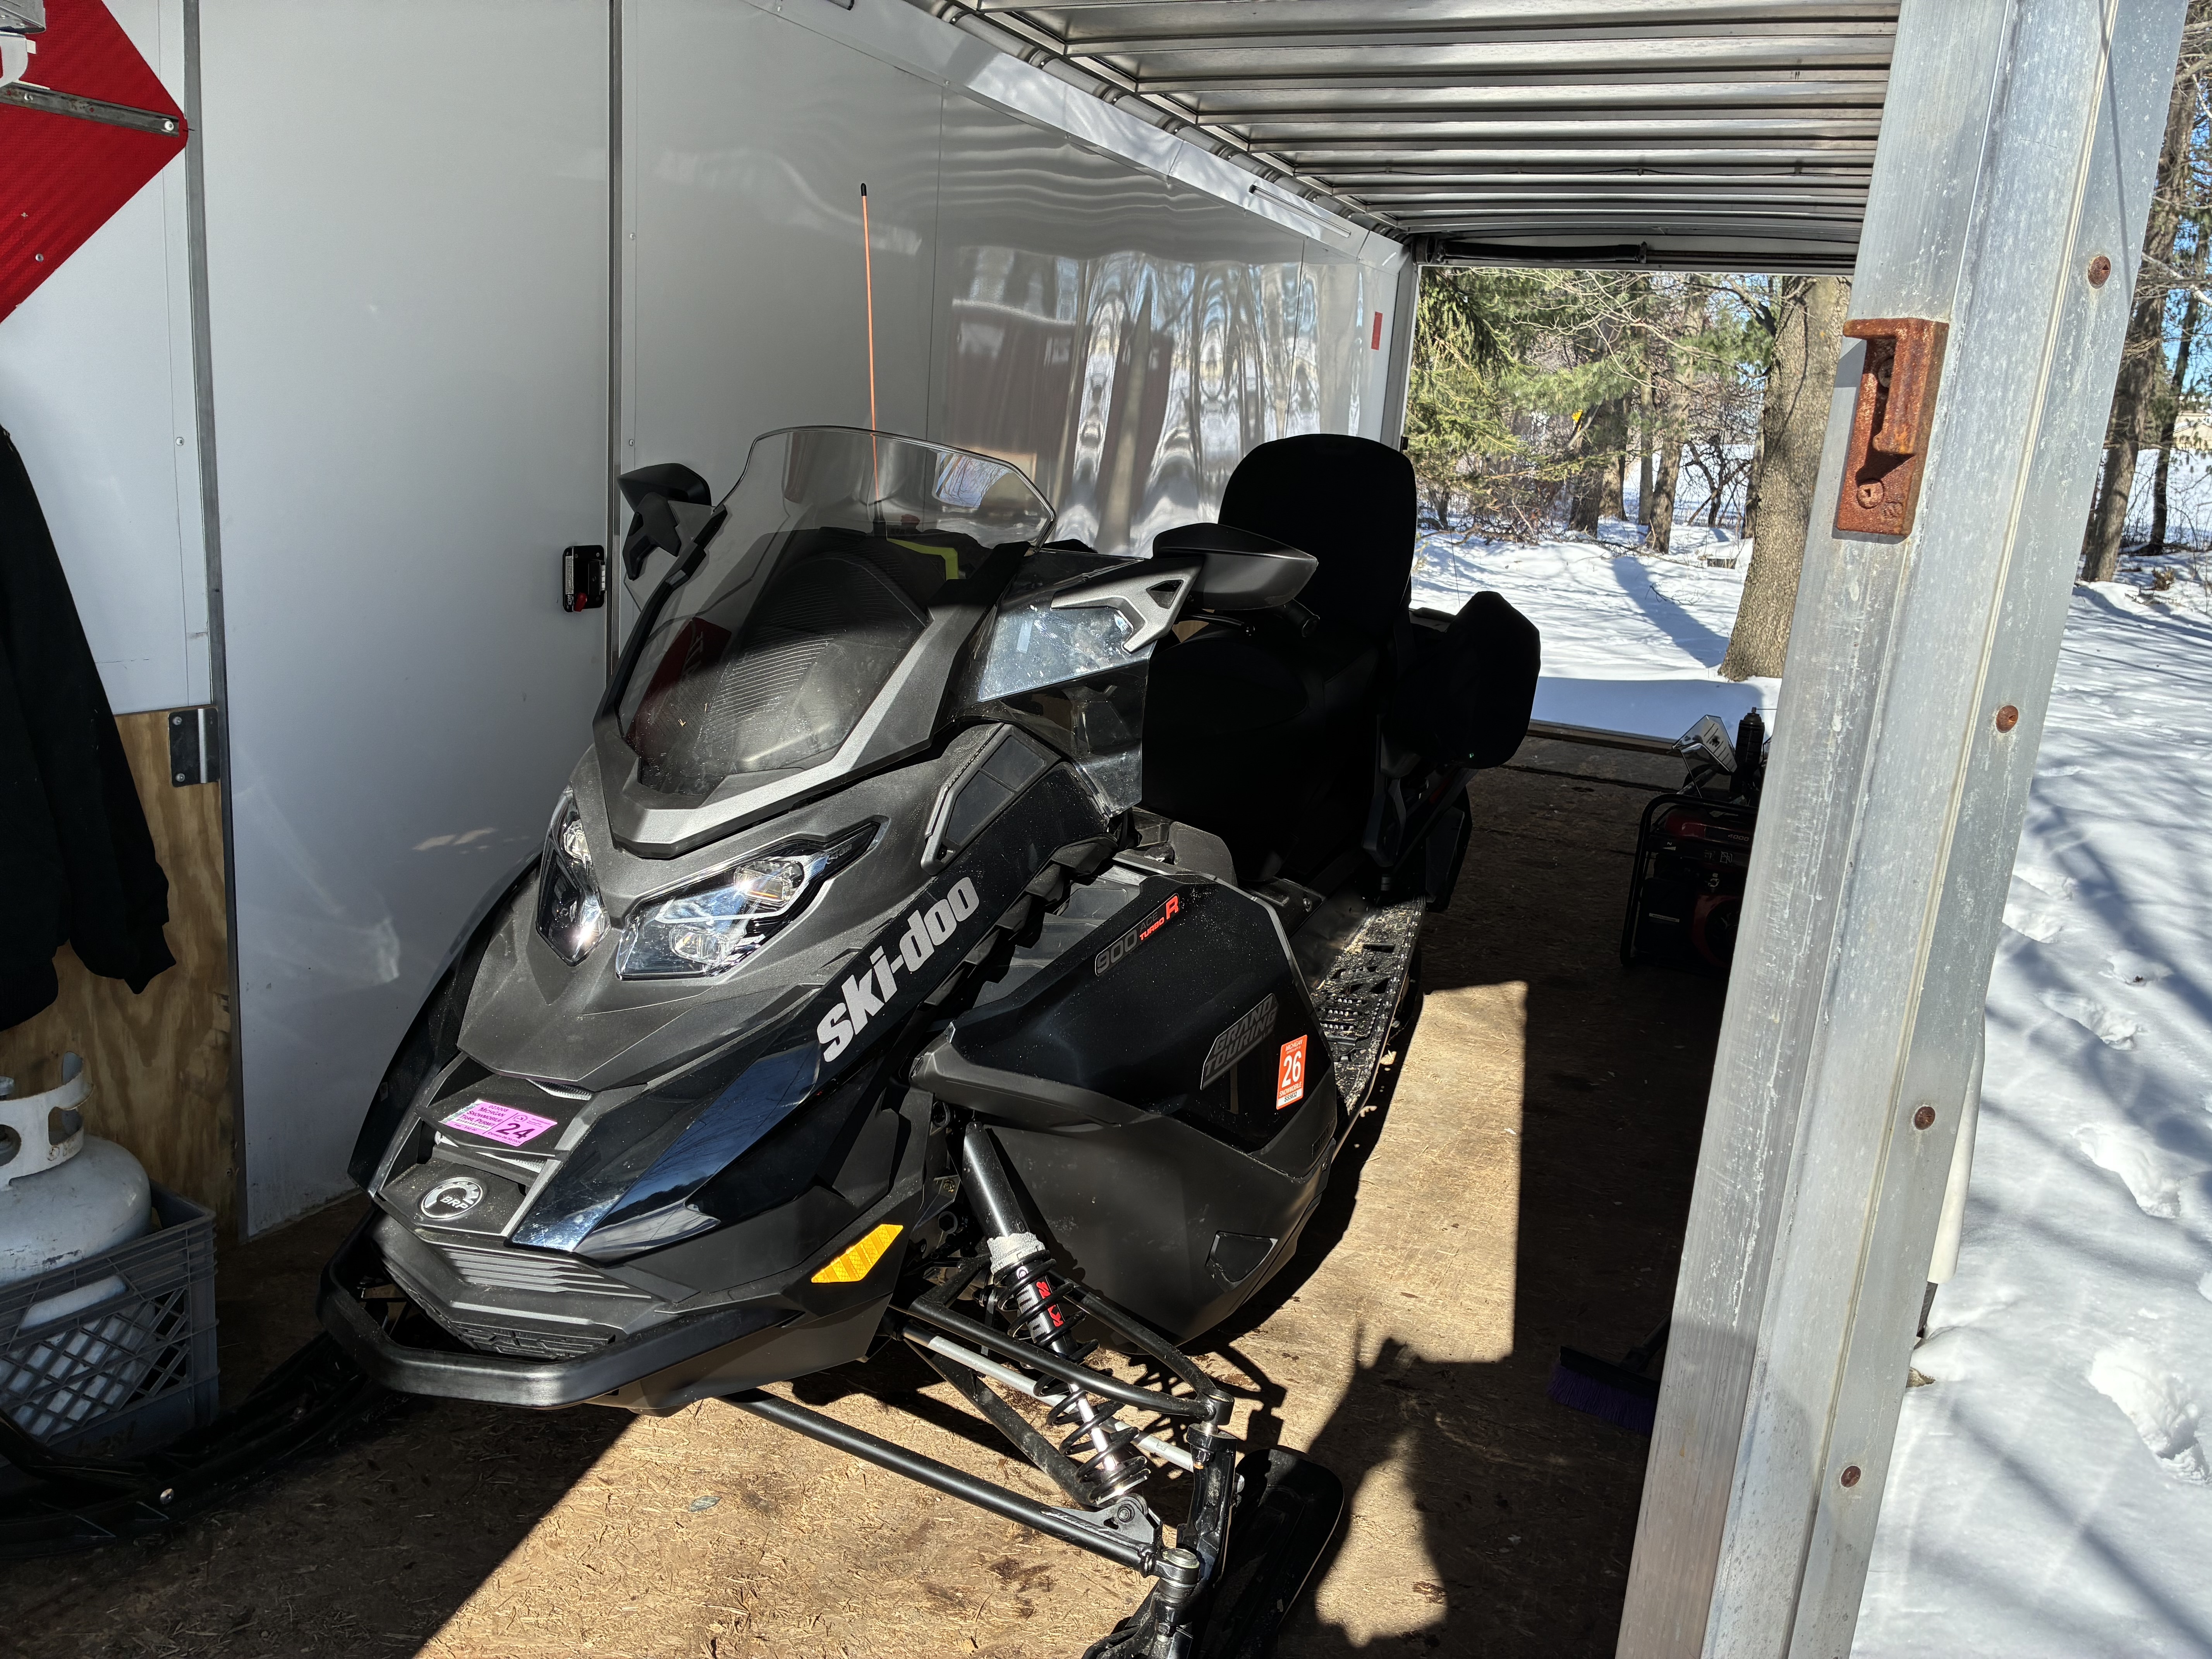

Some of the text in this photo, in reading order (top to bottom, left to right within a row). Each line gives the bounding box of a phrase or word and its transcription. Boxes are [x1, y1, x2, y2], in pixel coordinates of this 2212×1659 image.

[1140, 912, 1158, 933] ACE
[1097, 896, 1179, 974] 900 TURBO R
[817, 877, 979, 1062] ski-doo
[1213, 996, 1273, 1055] GRAND
[1206, 1006, 1278, 1077] TOURING
[1285, 1039, 1303, 1051] MICHIGAN
[1281, 1051, 1302, 1088] 26
[1279, 1082, 1302, 1097] SNOWMOBILE
[466, 1111, 503, 1122] SNOWMOBILE
[478, 1107, 506, 1117] MICHIGAN
[474, 1118, 496, 1127] PERMIT
[495, 1123, 536, 1139] 24
[440, 1196, 469, 1209] BRP
